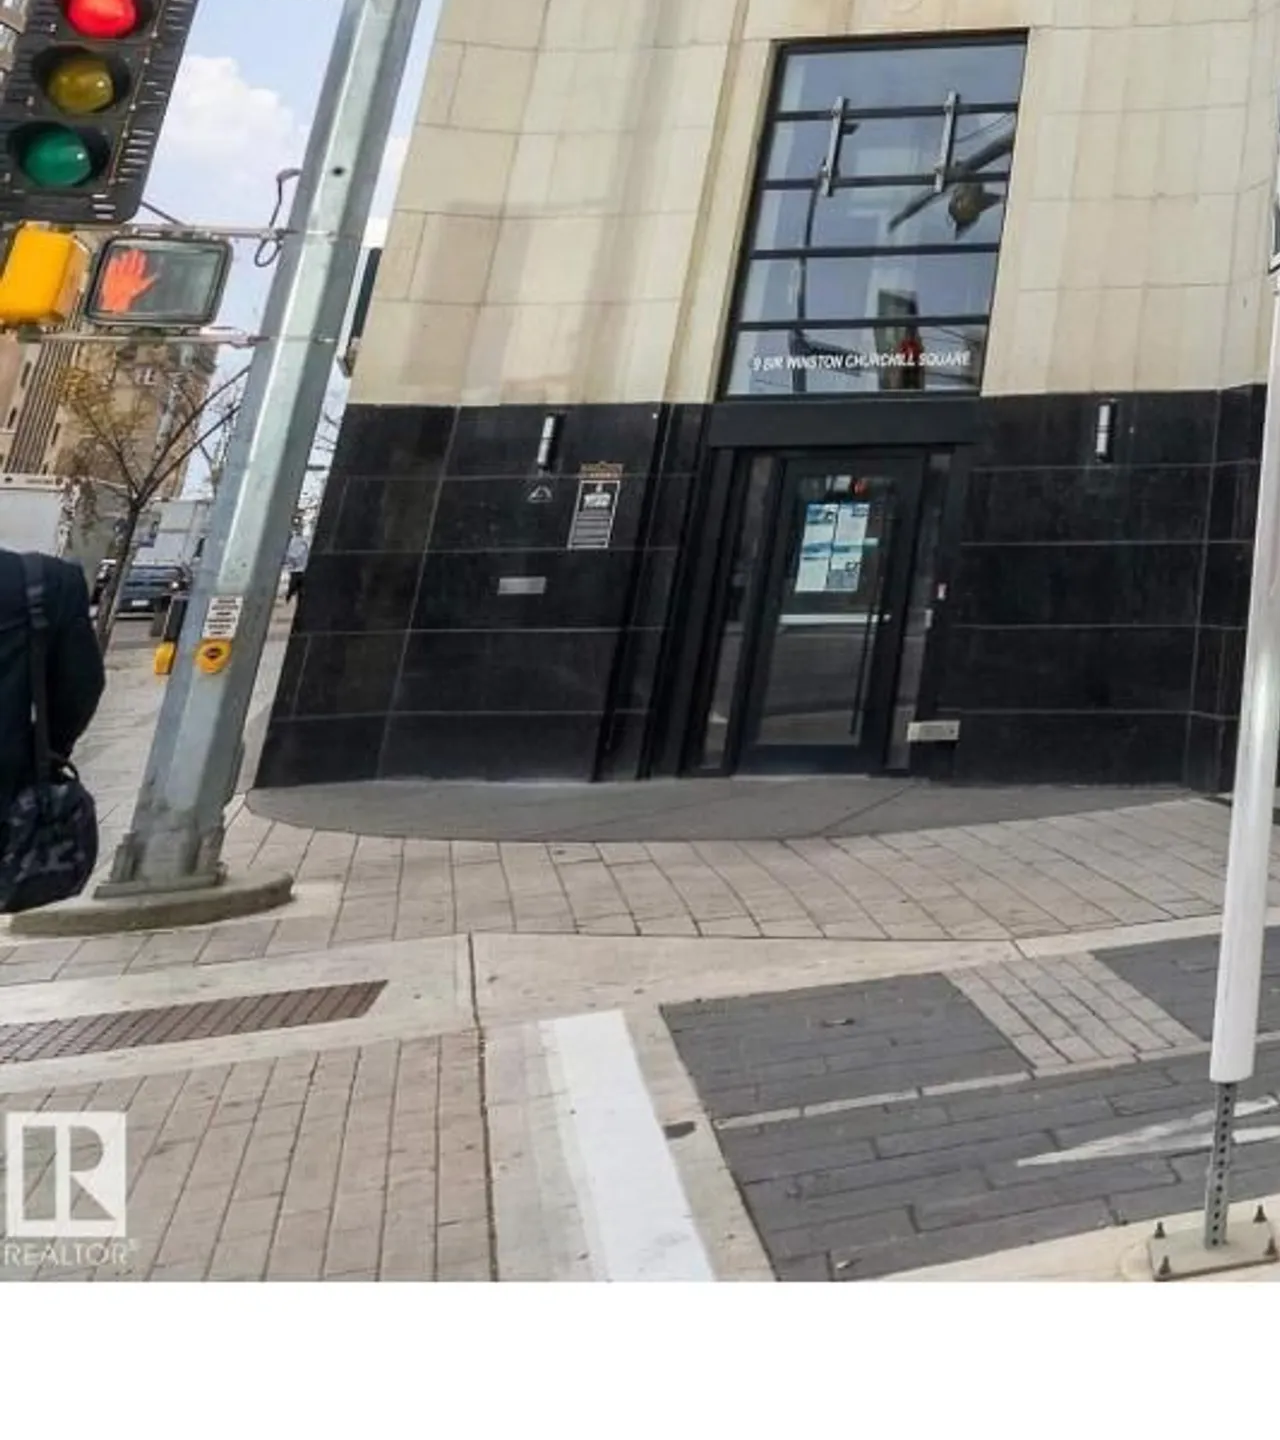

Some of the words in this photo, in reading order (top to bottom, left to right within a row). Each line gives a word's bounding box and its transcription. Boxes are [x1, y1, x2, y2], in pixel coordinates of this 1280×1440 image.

[786, 354, 844, 370] WINSTON
[845, 350, 916, 368] CHURCHILL
[919, 350, 971, 367] SQUARE
